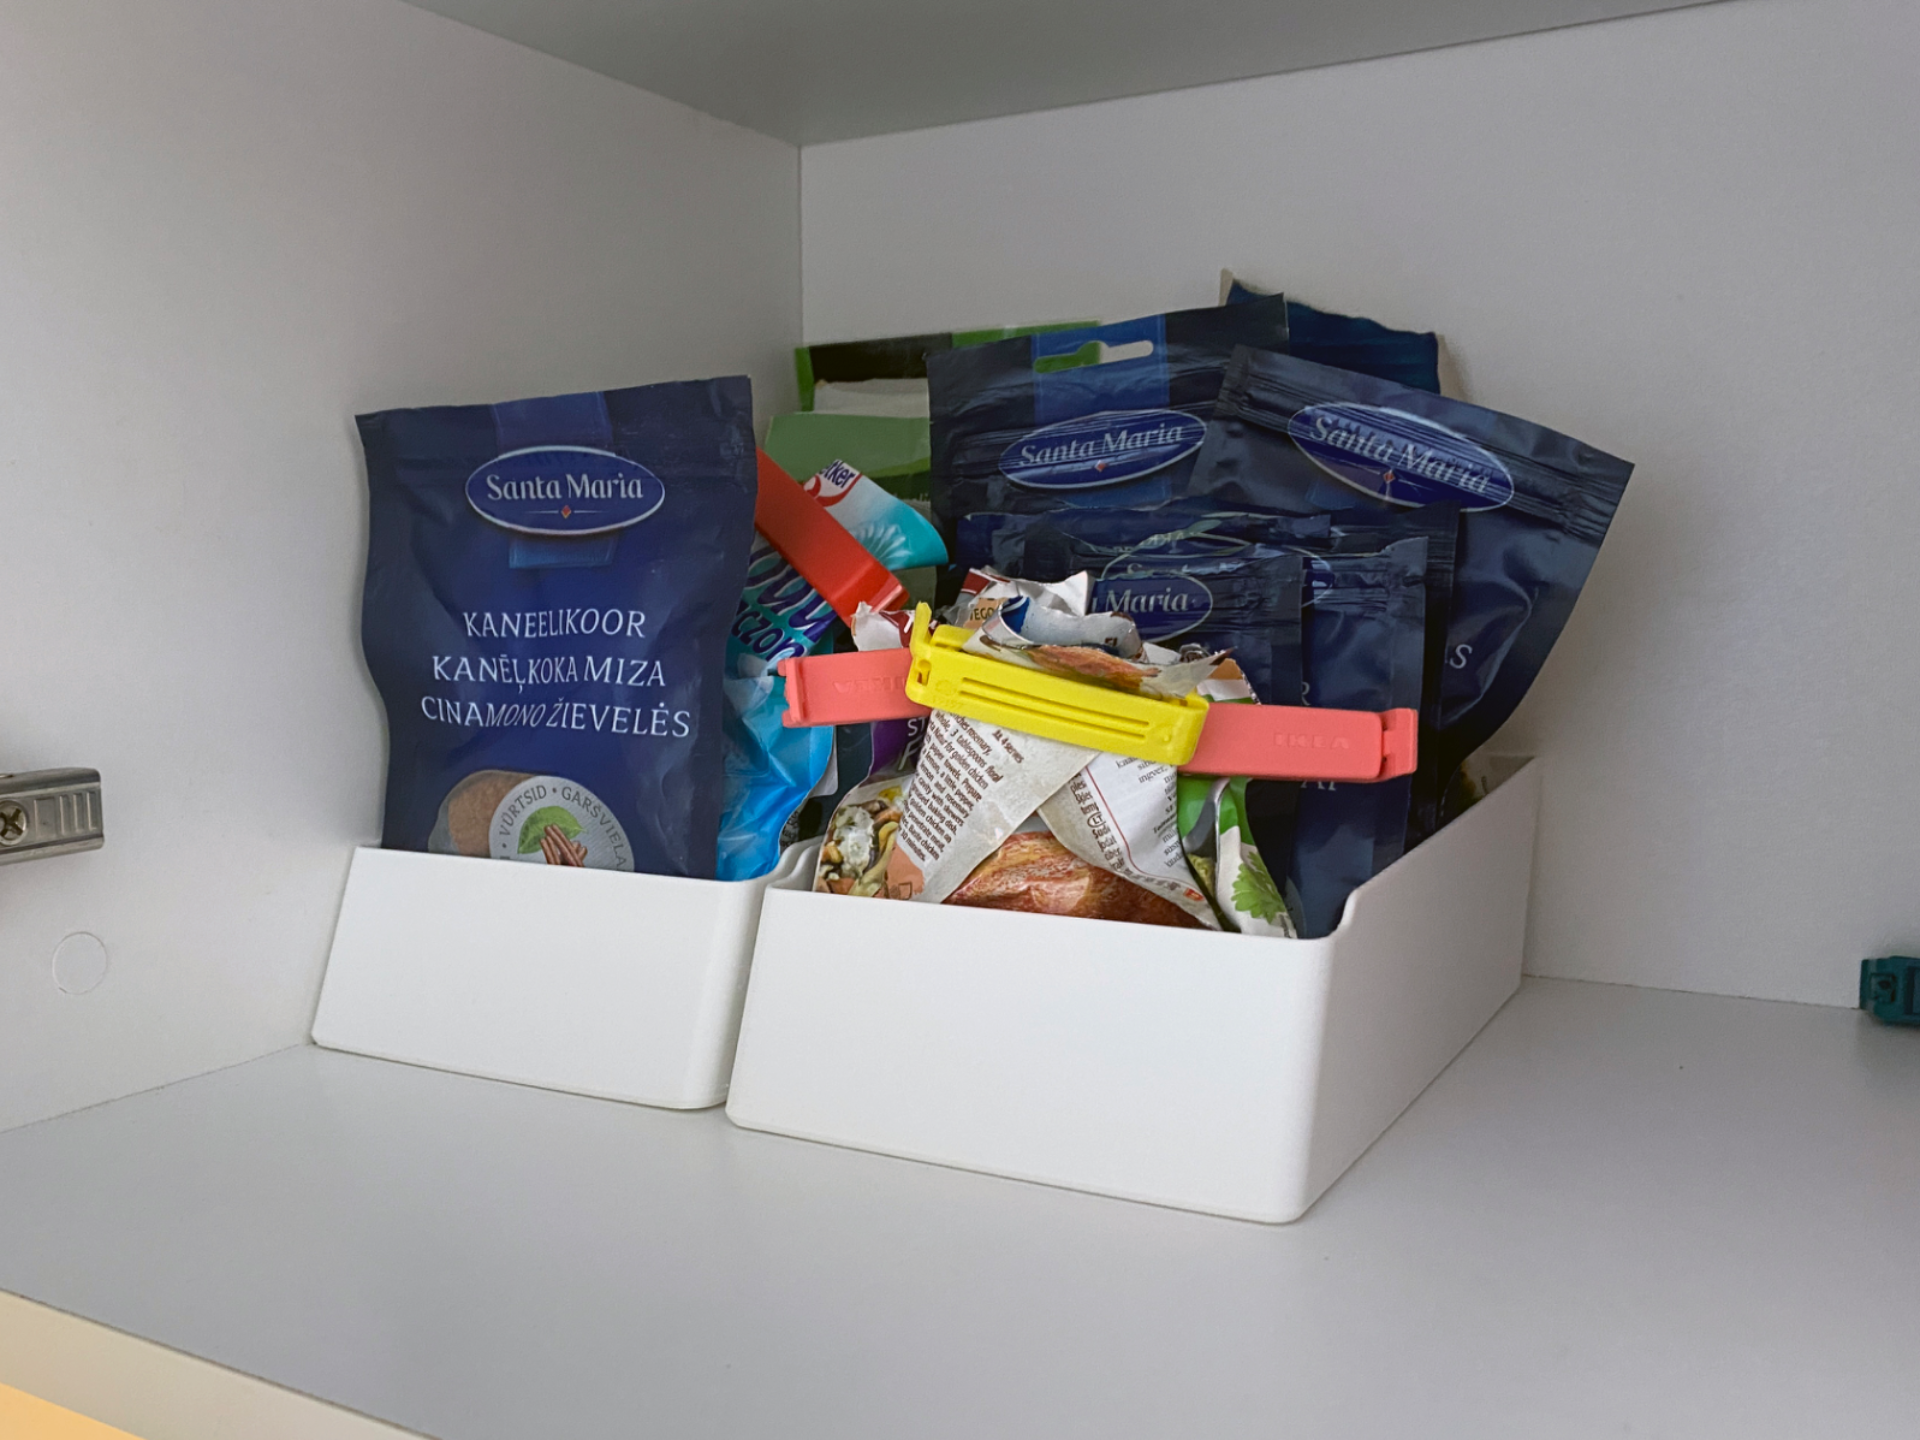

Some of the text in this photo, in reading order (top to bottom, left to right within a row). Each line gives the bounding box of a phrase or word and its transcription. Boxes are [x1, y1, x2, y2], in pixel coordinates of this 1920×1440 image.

[1020, 422, 1184, 467] Santa Maria
[1310, 416, 1492, 495] Santa Maria
[486, 472, 644, 501] Santa Maria
[1106, 587, 1189, 613] Maria
[463, 608, 647, 639] KANEELIKOOR
[432, 653, 666, 694] KANĒĻKOKA MIZA
[420, 695, 691, 738] CINAMONO ŽIEVELĖS
[955, 735, 987, 768] tablespoons
[1004, 742, 1024, 763] serves
[1274, 733, 1350, 750] IKEA
[944, 742, 955, 753] for
[950, 750, 970, 771] golden
[968, 767, 989, 789] chicken
[561, 786, 628, 870] GARŠVIELA
